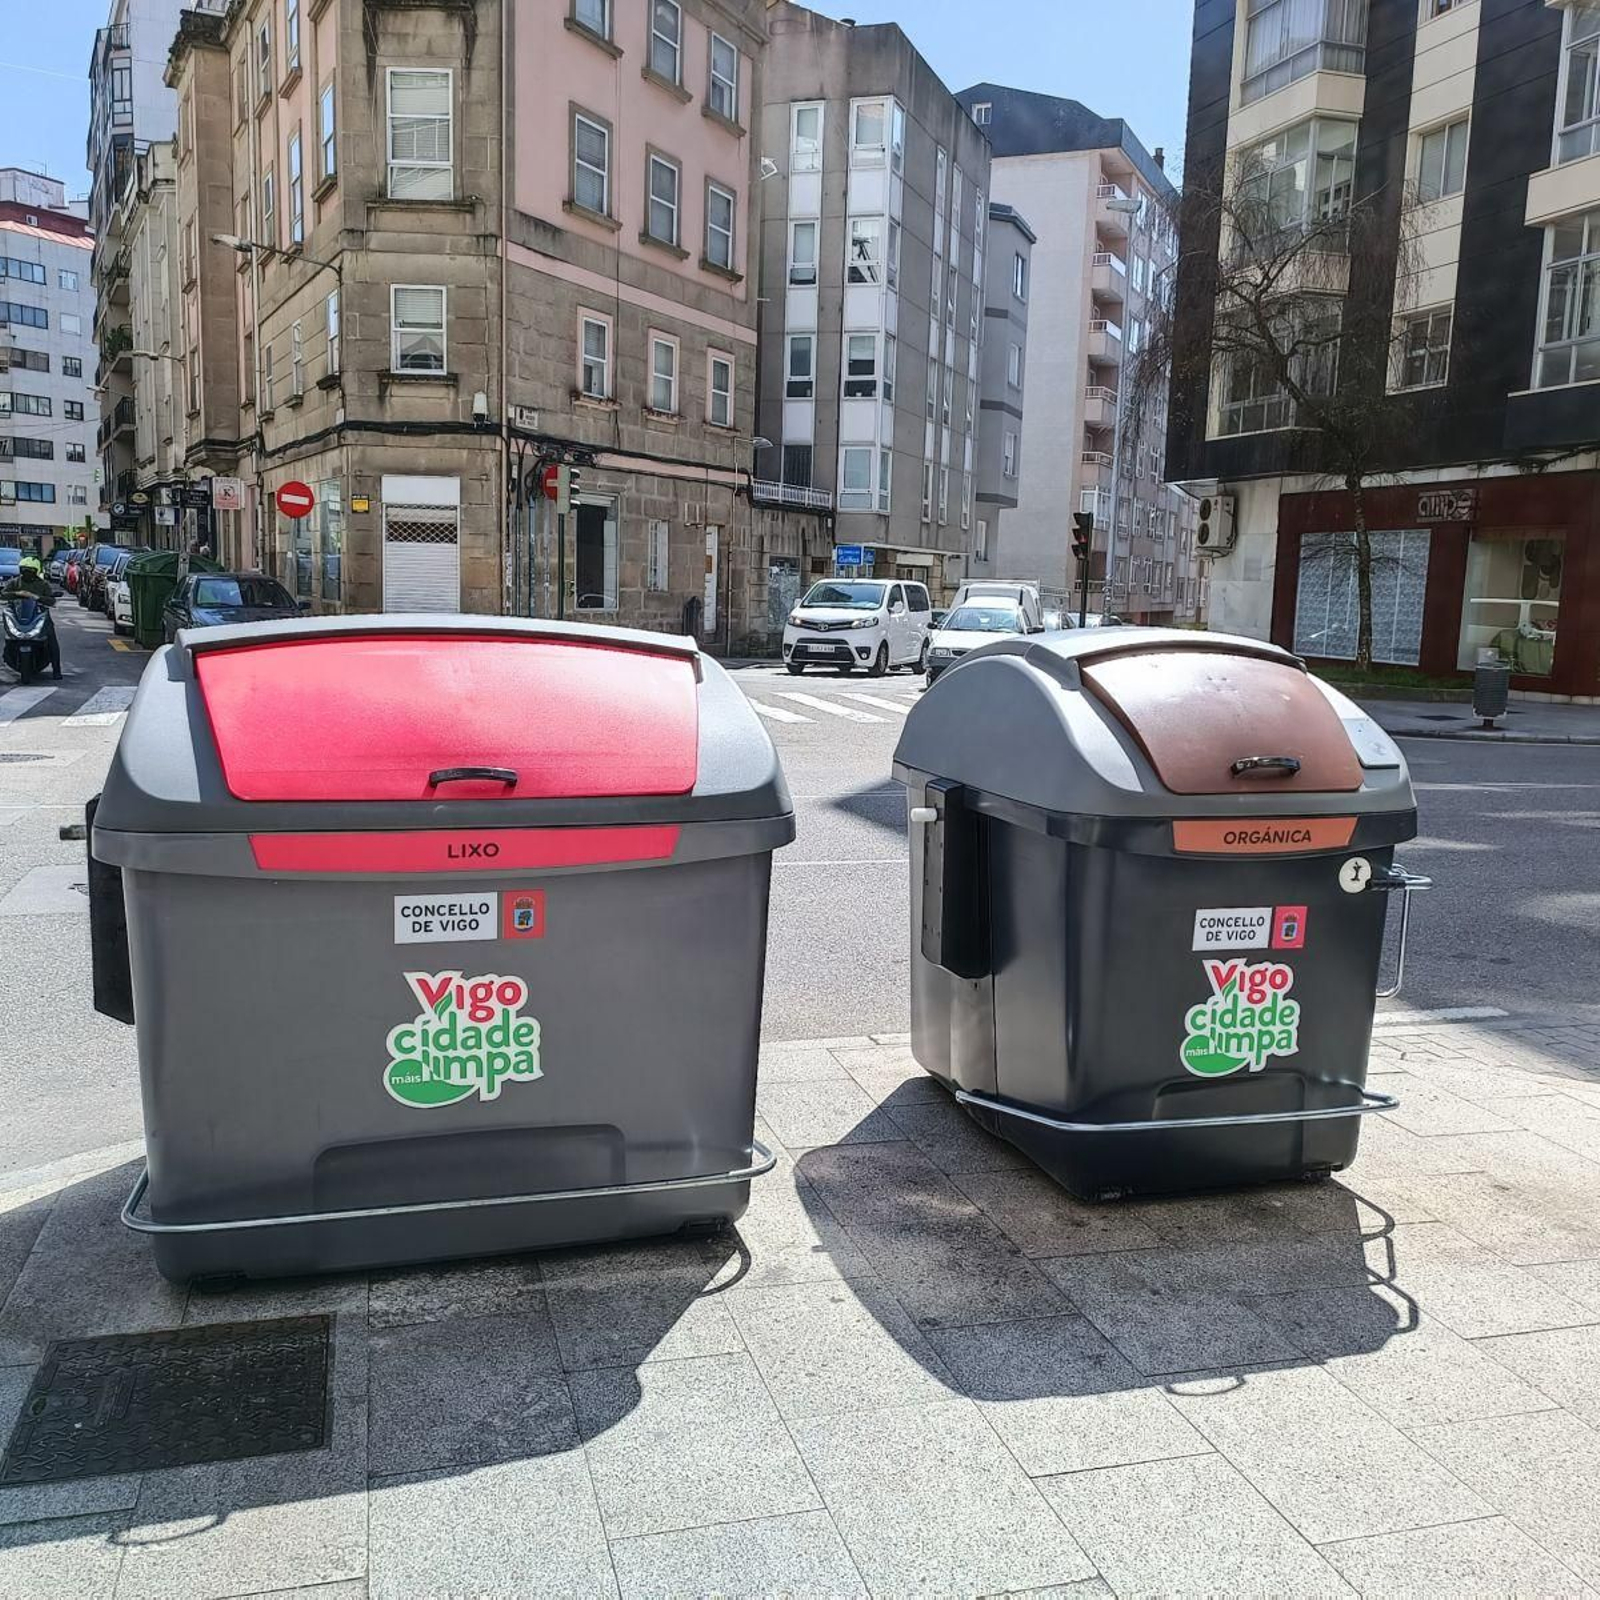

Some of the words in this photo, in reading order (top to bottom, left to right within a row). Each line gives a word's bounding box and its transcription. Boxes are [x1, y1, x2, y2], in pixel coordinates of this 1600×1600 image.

[1223, 827, 1312, 845] ORGÁNICA
[448, 843, 500, 858] LIXO
[401, 903, 490, 918] CONCELLO
[1199, 916, 1265, 929] CONCELLO
[412, 921, 433, 933] DE
[439, 918, 480, 932] VIGO
[1206, 931, 1222, 942] DE
[1226, 930, 1257, 941] VIGO
[1211, 964, 1289, 1004] Vigo
[415, 977, 522, 1023] Vigo
[1190, 991, 1296, 1031] cidade
[394, 1008, 535, 1054] cidade
[1186, 1046, 1208, 1057] máis
[1209, 1027, 1293, 1066] limpa
[391, 1071, 422, 1085] máis
[422, 1050, 535, 1094] limpa
